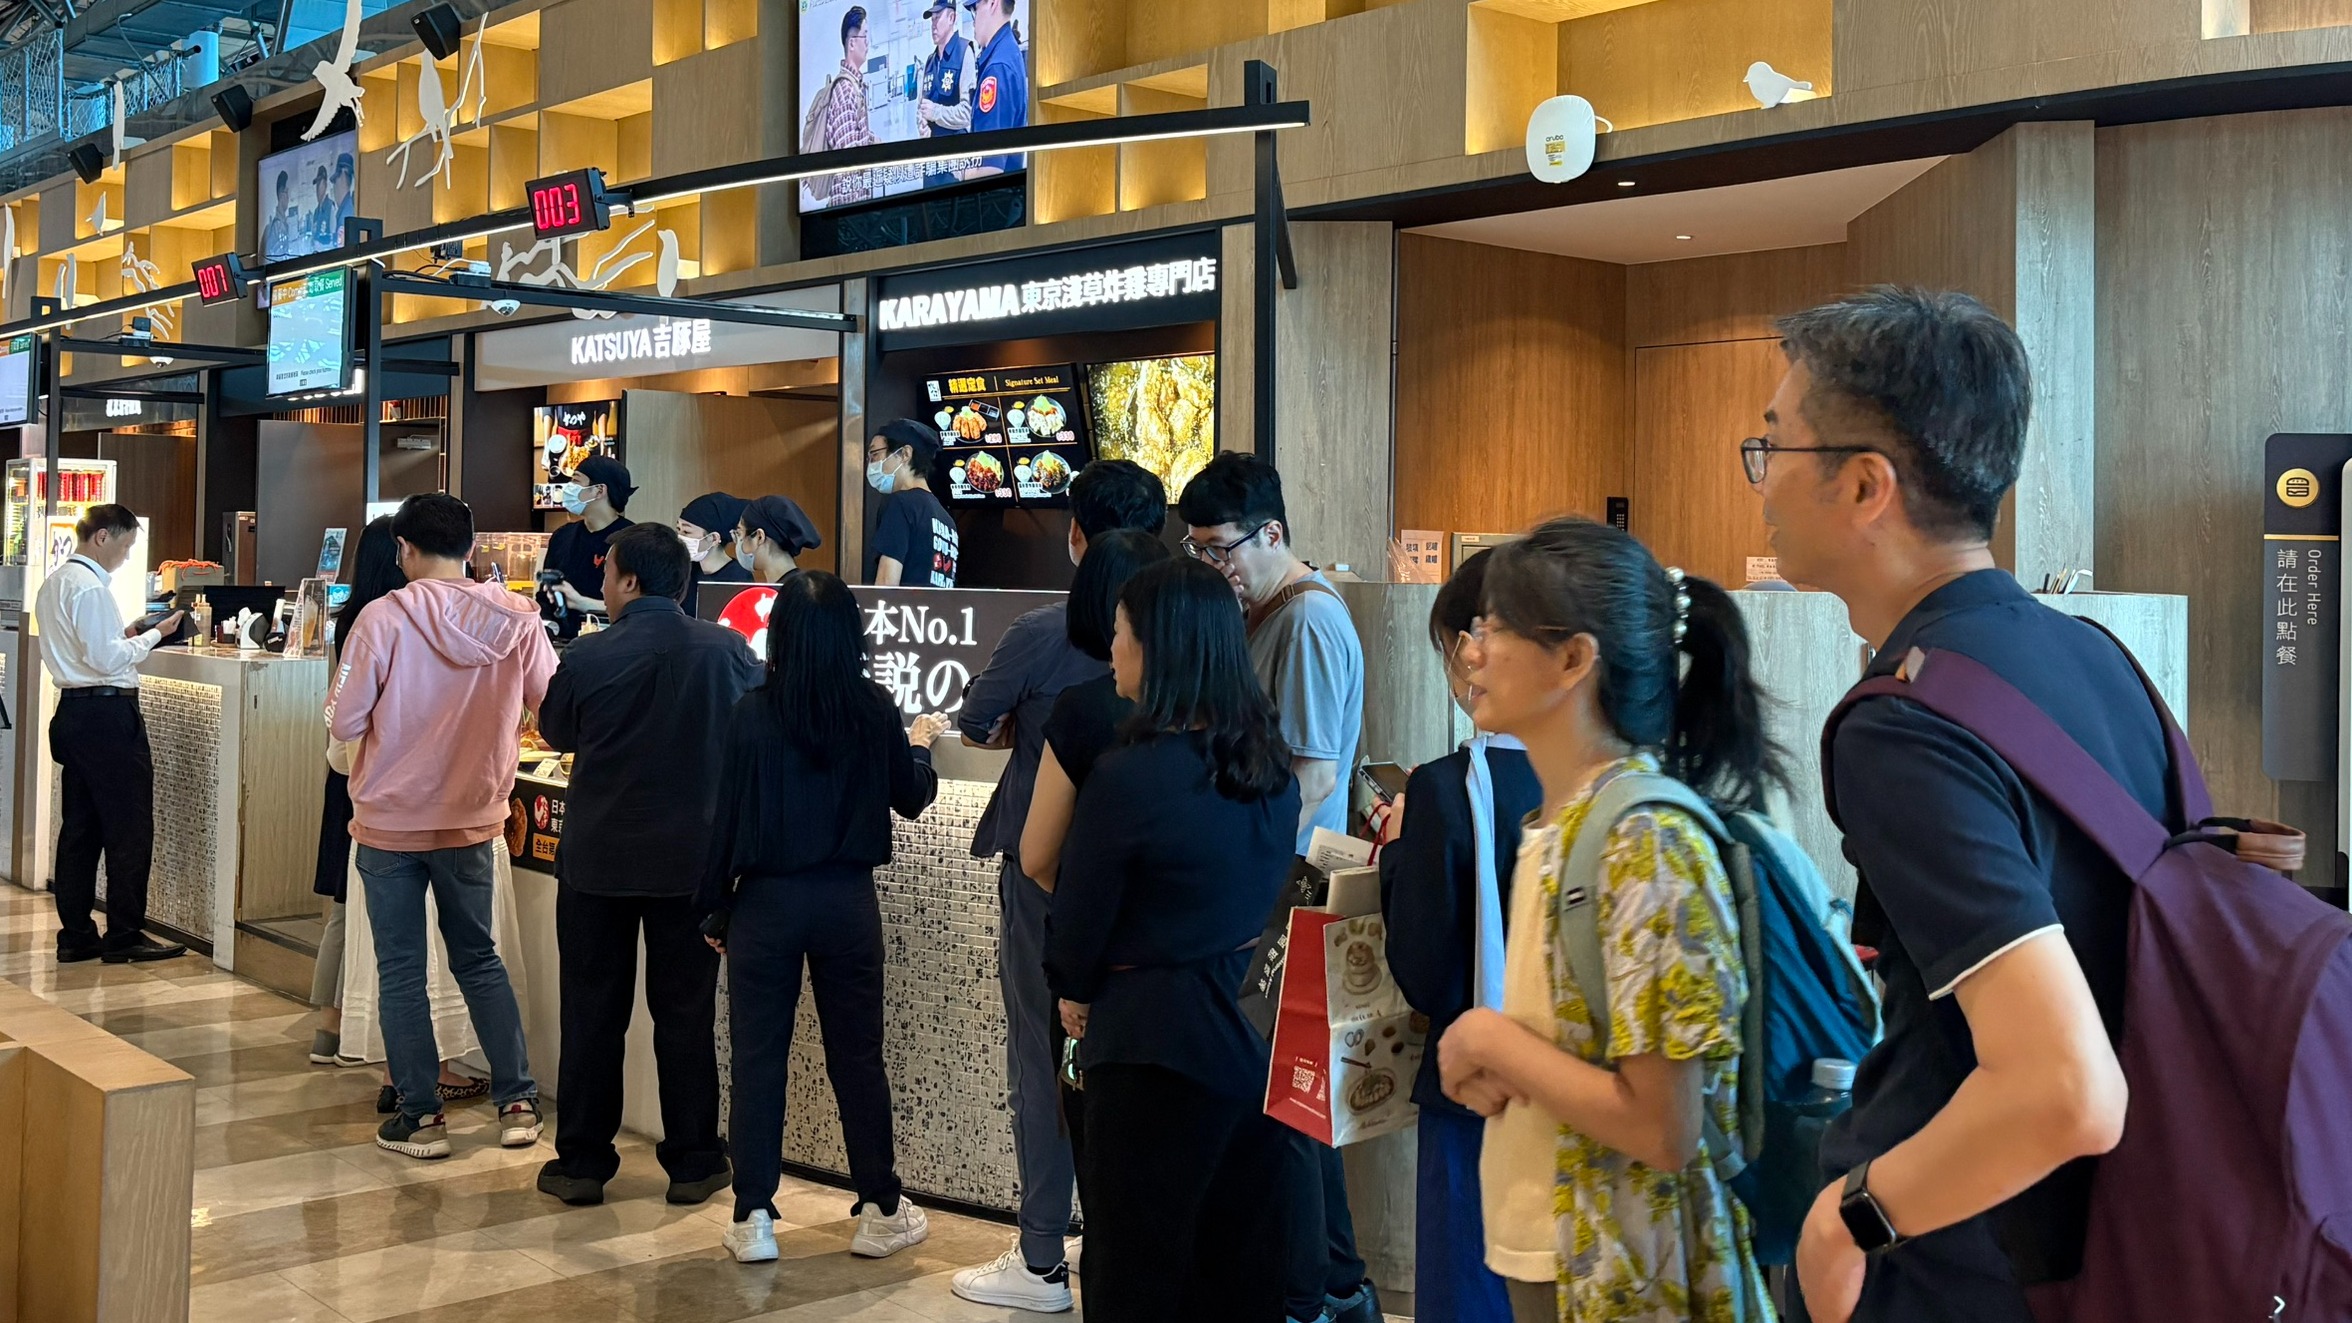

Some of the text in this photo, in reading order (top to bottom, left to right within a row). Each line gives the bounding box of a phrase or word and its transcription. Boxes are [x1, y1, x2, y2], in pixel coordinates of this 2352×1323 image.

[534, 184, 581, 230] 003
[197, 264, 228, 298] 007
[879, 284, 1021, 330] KARAYAMA
[571, 319, 711, 365] KATSUYA 吉豚屋
[1004, 375, 1060, 388] Signature Set Meal
[2275, 548, 2299, 666] 請在此點餐
[2306, 549, 2322, 626] Order Here
[858, 600, 979, 647] 本No.1
[859, 651, 971, 714] 説の
